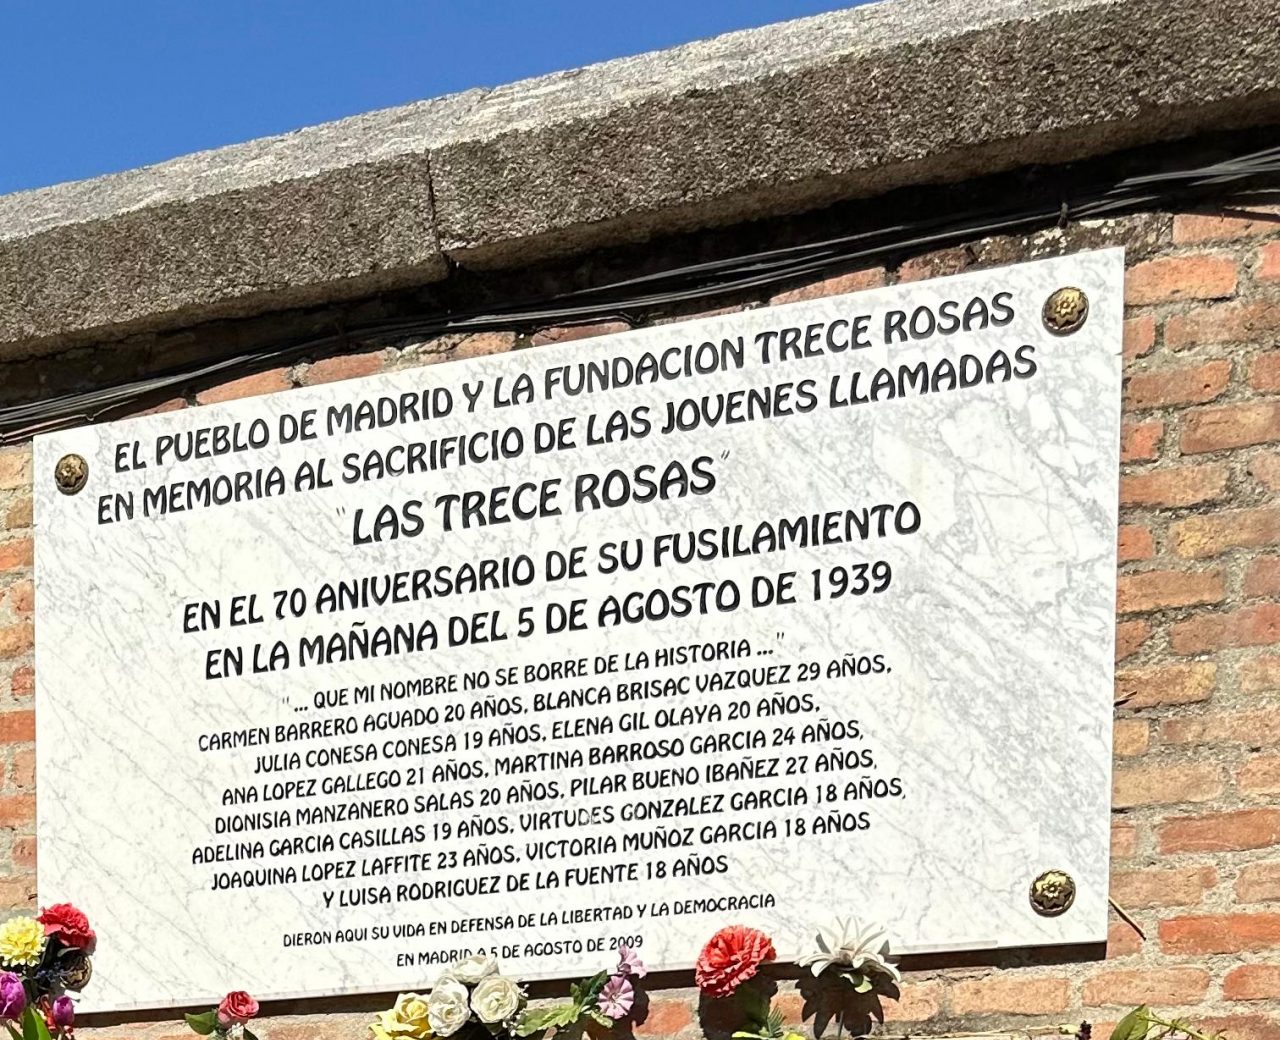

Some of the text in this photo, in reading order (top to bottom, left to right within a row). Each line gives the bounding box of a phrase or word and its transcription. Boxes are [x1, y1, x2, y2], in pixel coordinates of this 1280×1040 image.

[114, 291, 1015, 474] EL PUEBLO DE MADRID Y LA FUNDACION TRECE ROSAS
[97, 344, 1038, 525] EN MEMORIA AL SACRIFICIO DE LAS JOVENES LLAMADAS
[434, 477, 563, 532] TRECE
[183, 501, 922, 634] EN EL 70 ANIVERSARIO DE SU FUSILAMIENTO
[205, 560, 892, 681] EN LA MAÑANA DEL 5 DE AGOSTO DE 1939
[198, 652, 892, 752] CARMEN BARRERO AGUADO 20 AÑOS, BLANCA BRISAC VAZQUEZ 29 AÑOS,
[313, 688, 349, 710] QUE
[353, 684, 375, 705] MI
[380, 674, 458, 702] NOMBRE
[463, 670, 490, 691] NO
[494, 666, 519, 687] SE
[524, 657, 589, 684] BORRE
[593, 654, 619, 676] DE
[624, 651, 649, 672] LA
[654, 638, 751, 668] HISTORIA
[222, 718, 864, 806] ANA LOPEZ GALLEGO 21 AÑOS, MARTINA BARROSO GARCIA 24 AÑOS,
[283, 893, 776, 948] DIERON AQUI SU VIDA EN DEFENSA DE LA LIBERTAD Y LA DEMOCRACIA
[322, 853, 729, 909] Y LUISA RODRIGUEZ DE LA FUENTE 18 AÑOS
